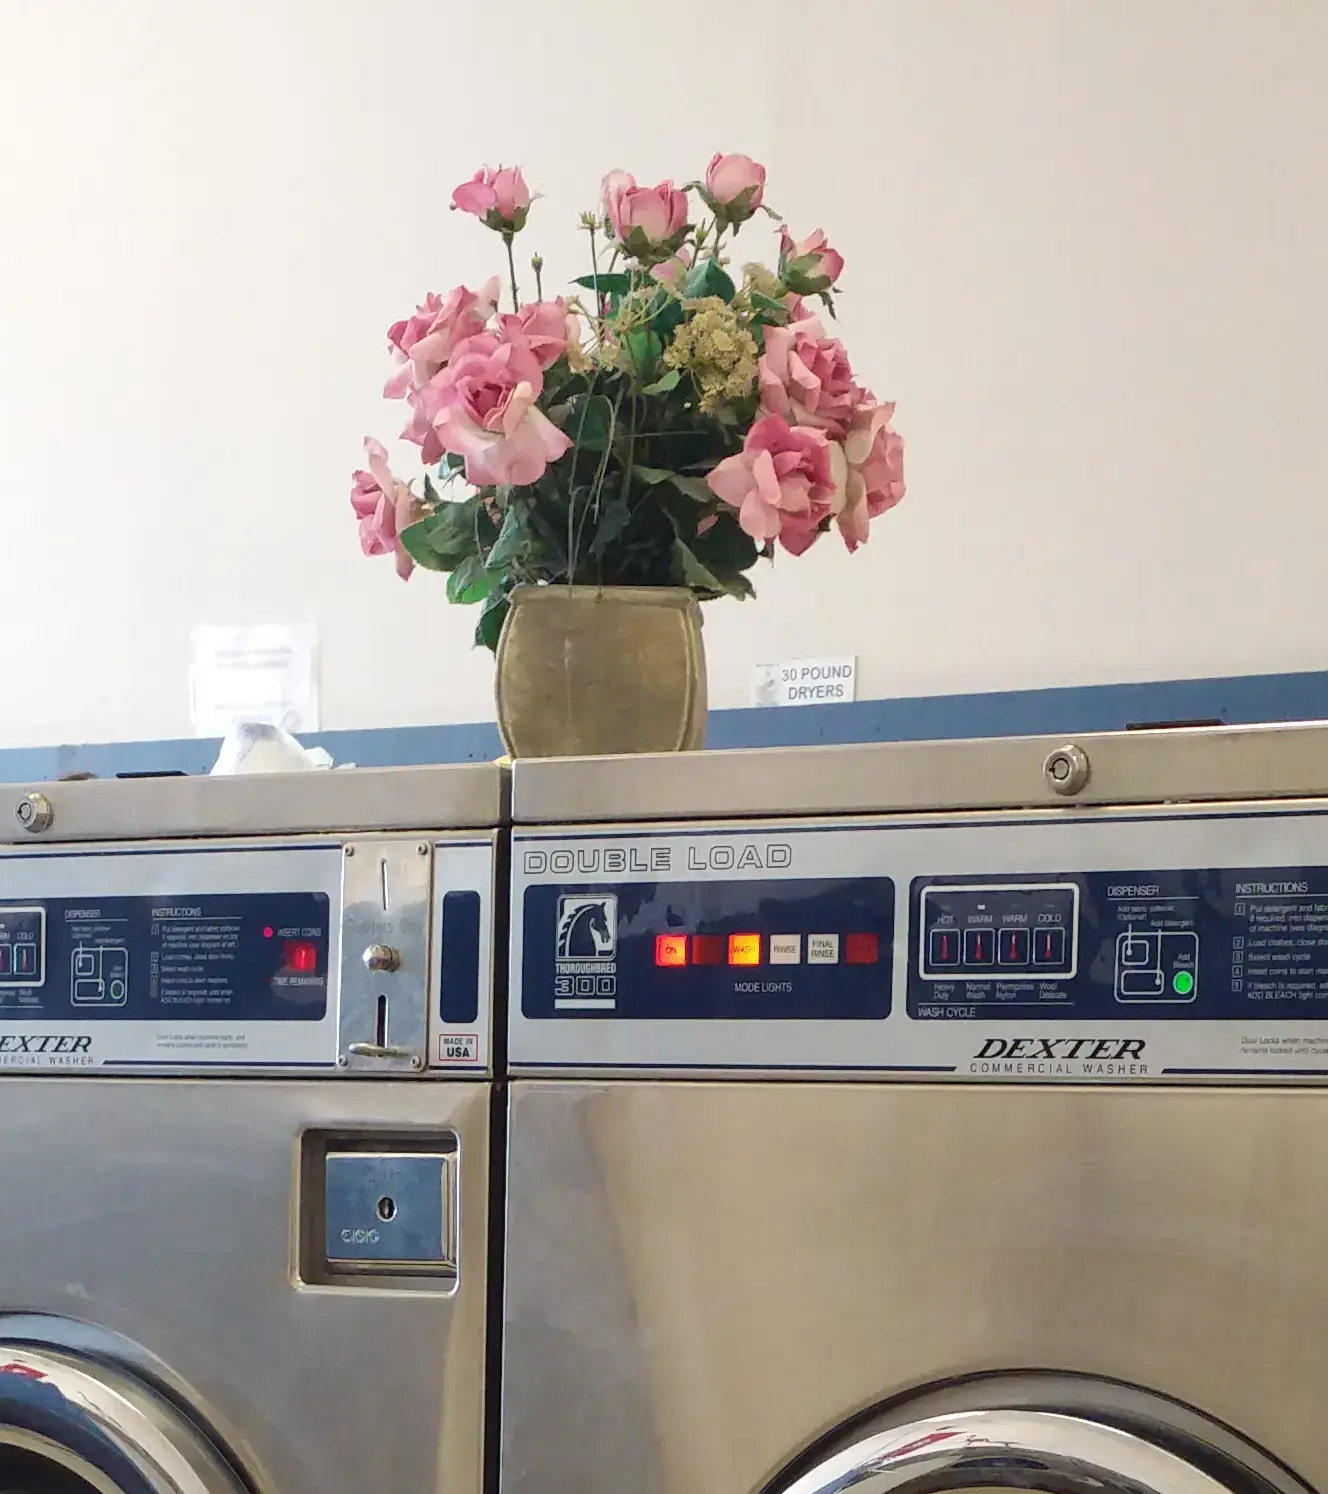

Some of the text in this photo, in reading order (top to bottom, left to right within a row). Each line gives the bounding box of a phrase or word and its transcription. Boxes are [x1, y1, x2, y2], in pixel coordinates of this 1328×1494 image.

[781, 665, 852, 682] 30 POUND
[788, 684, 844, 700] DRYERS
[523, 844, 792, 874] DOUBLE LOAD
[1107, 885, 1160, 897] DISPENSER
[1235, 882, 1308, 894] INSTRUCTIONS
[152, 907, 202, 917] INSTRUCTIONS
[937, 913, 1062, 925] HOT WARM WARM COLD
[812, 939, 834, 948] FINAL
[664, 945, 678, 955] ON
[732, 945, 756, 955] WASH
[773, 945, 797, 955] RINSE
[811, 949, 834, 959] RINSE
[555, 963, 616, 974] THOROUGHBRED
[554, 976, 616, 996] 300
[734, 981, 792, 993] MODE LIGHTS
[966, 982, 991, 991] Normal
[966, 991, 986, 999] Wash
[1264, 991, 1297, 999] BLEACH
[918, 1007, 976, 1018] WASH CYCLE
[443, 1037, 473, 1046] MADE IN
[446, 1046, 470, 1058] USA
[973, 1038, 1146, 1061] DEXTER
[48, 1056, 94, 1065] WASHER
[969, 1062, 1148, 1075] COMMERCIAL WASHER
